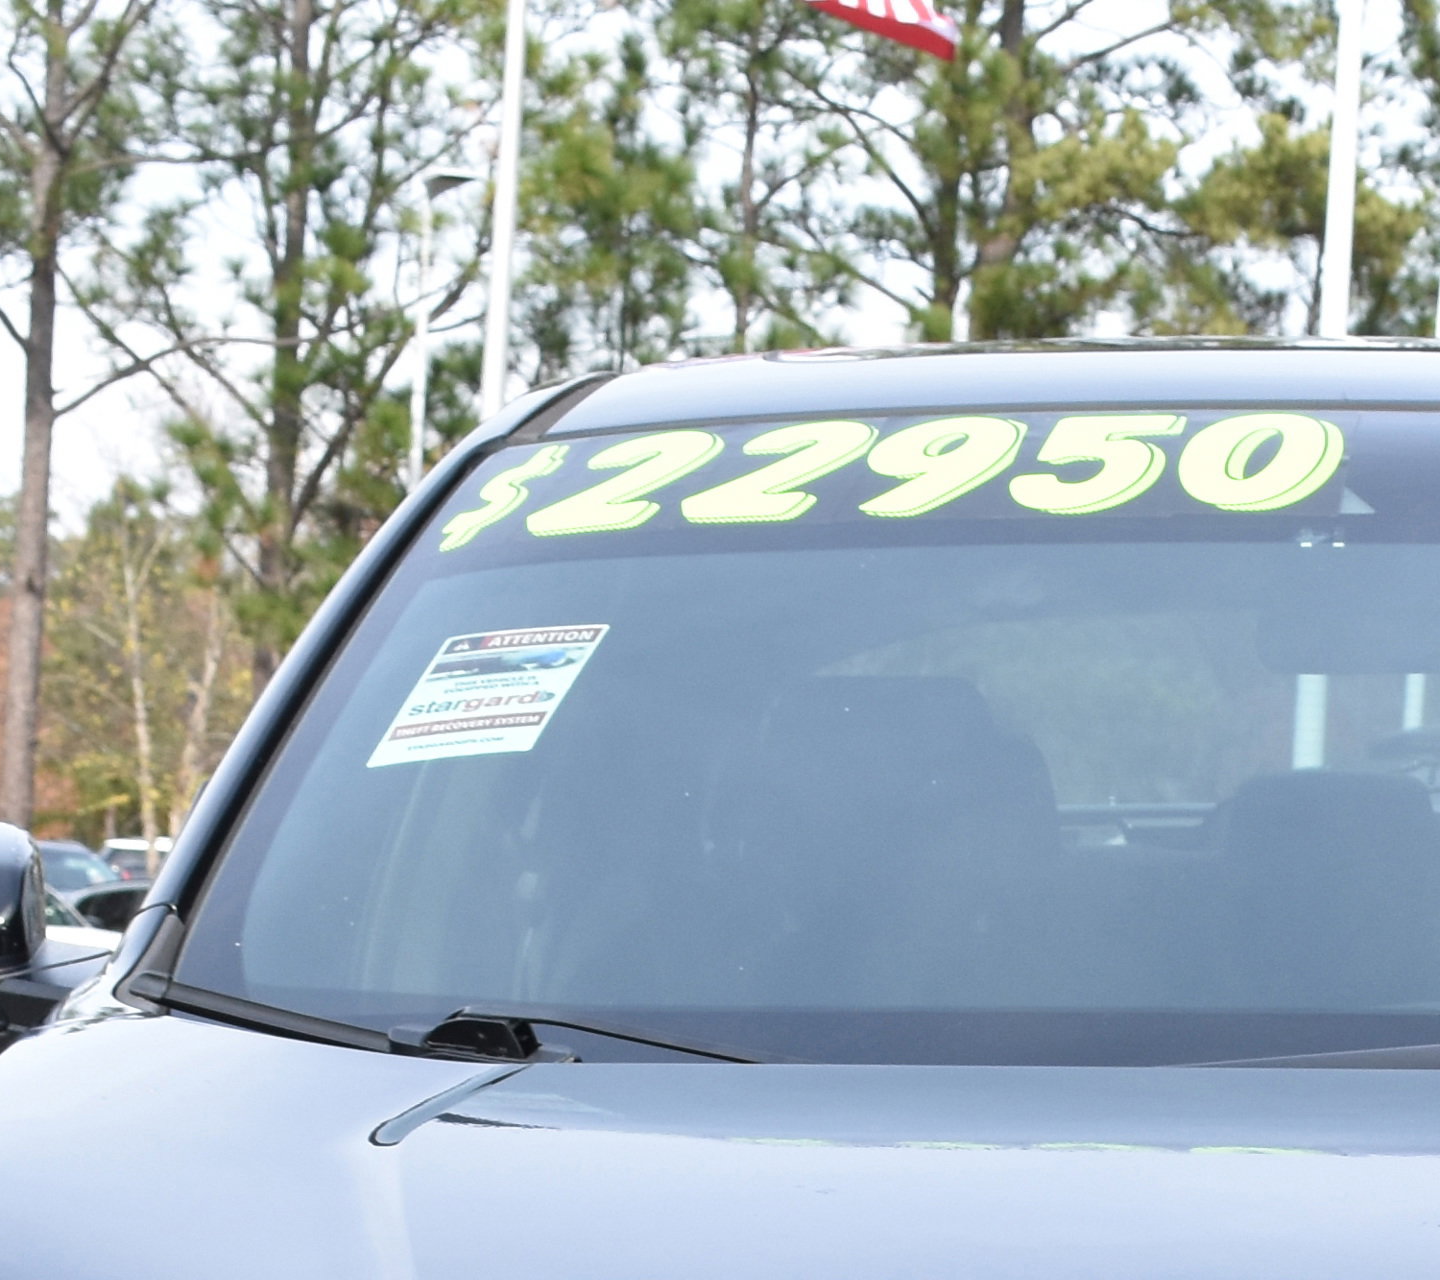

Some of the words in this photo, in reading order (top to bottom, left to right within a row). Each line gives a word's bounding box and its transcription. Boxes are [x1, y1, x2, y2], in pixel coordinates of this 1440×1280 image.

[439, 412, 1345, 552] $22950
[487, 630, 595, 648] ATTENTION
[408, 690, 541, 717] stargard
[431, 719, 492, 731] RECOVERY
[493, 715, 540, 726] SYSTEM
